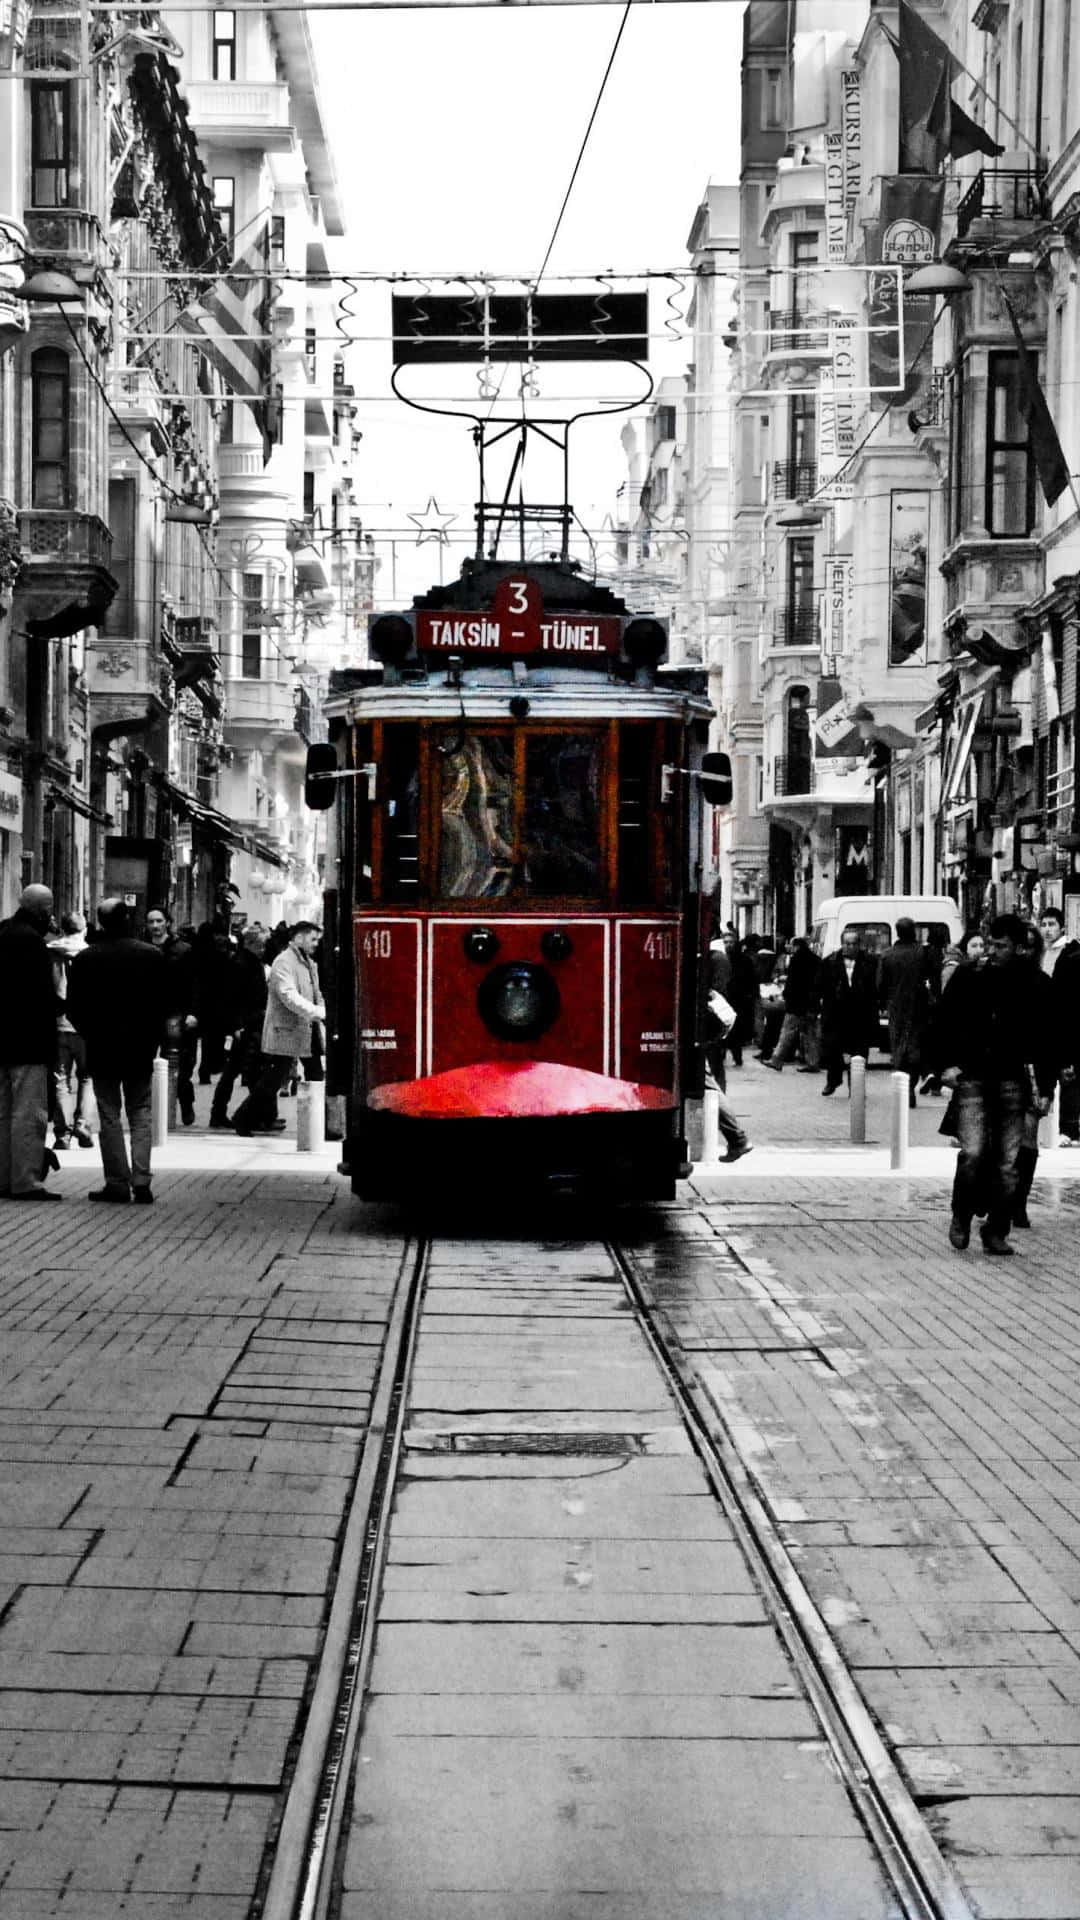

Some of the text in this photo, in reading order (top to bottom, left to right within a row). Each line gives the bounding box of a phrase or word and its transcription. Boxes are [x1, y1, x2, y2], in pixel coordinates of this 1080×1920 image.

[845, 86, 861, 195] KURSLARI
[508, 582, 529, 614] 3
[832, 565, 845, 609] IELTS
[429, 617, 500, 647] TAKSİM
[540, 620, 606, 650] TÜNEL
[846, 843, 869, 866] M
[363, 930, 391, 958] 410
[643, 931, 671, 960] 410
